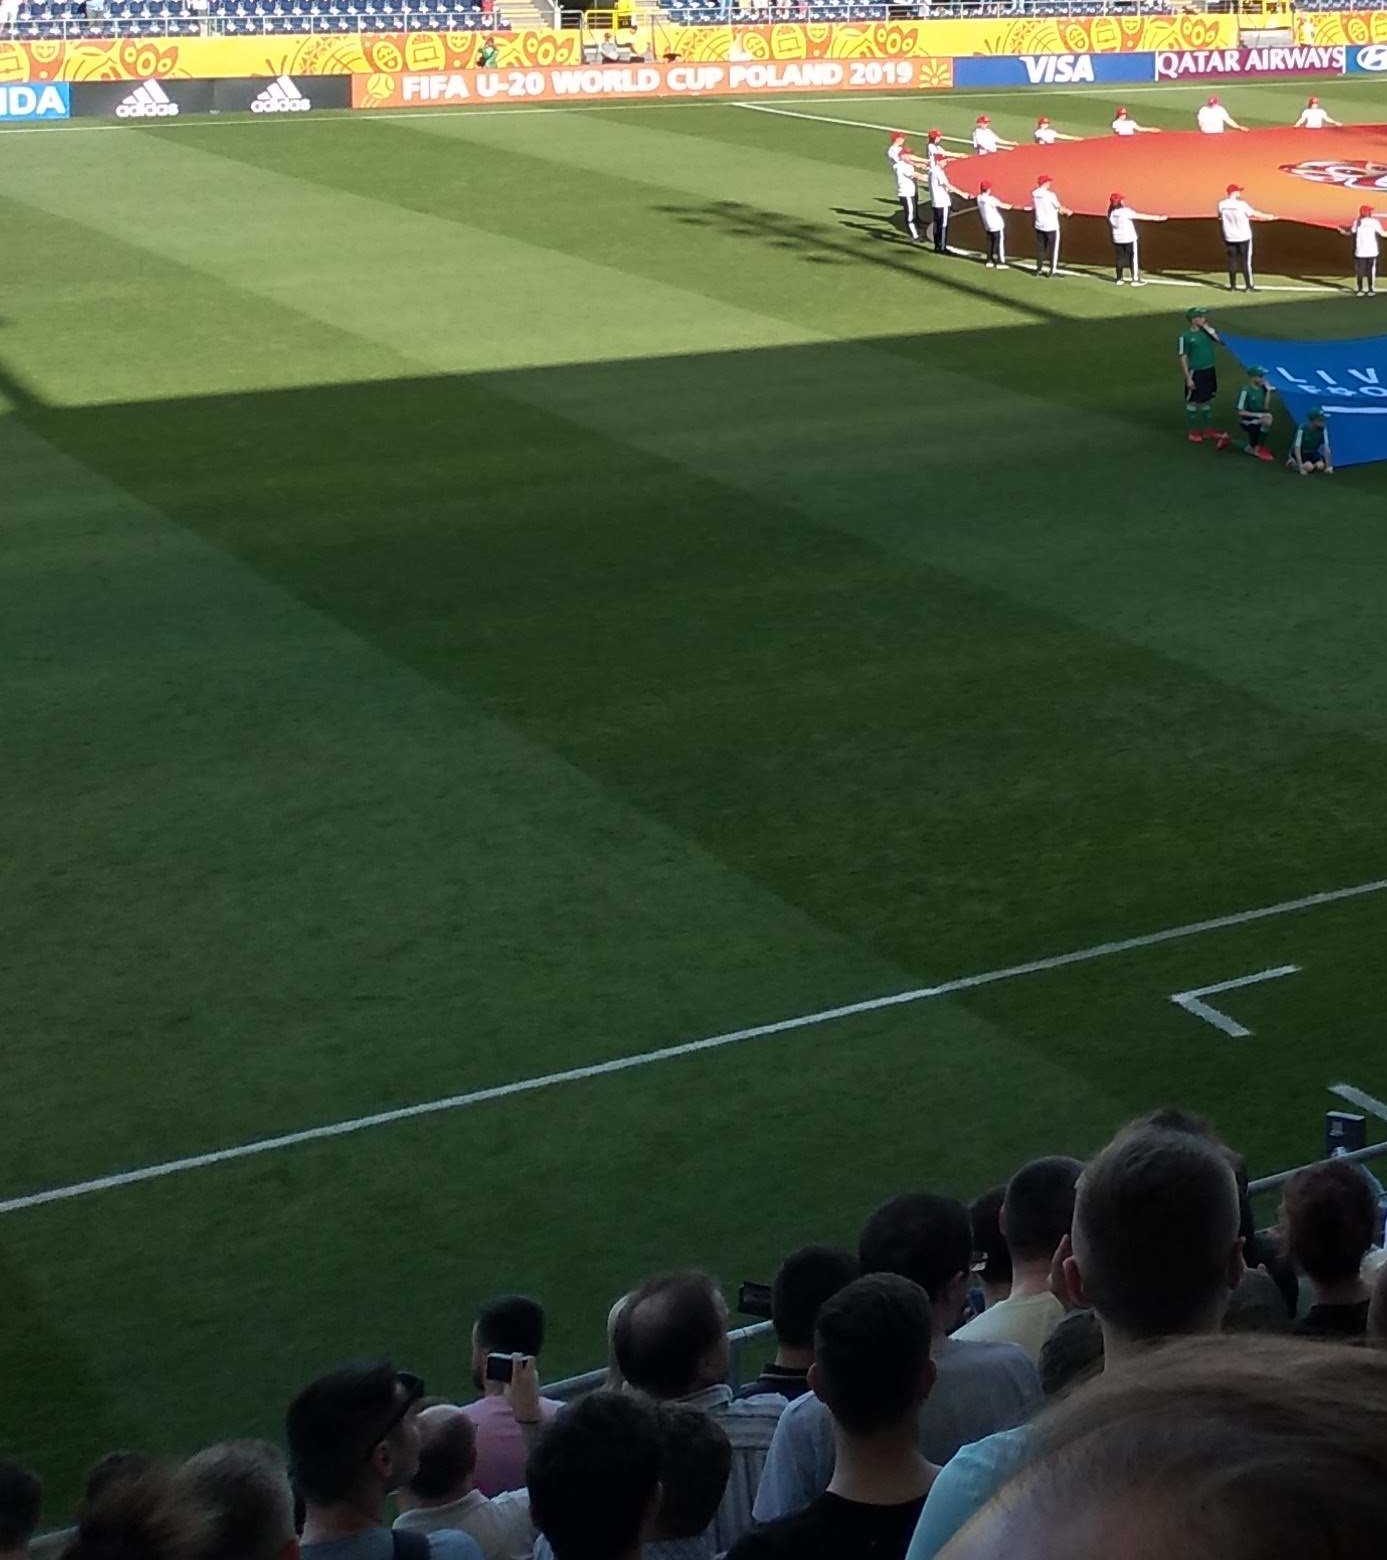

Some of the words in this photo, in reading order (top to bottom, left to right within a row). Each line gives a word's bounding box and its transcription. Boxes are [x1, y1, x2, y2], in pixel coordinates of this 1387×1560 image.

[1018, 54, 1094, 84] VISA
[1158, 49, 1240, 79] QATAR
[1245, 45, 1345, 73] AIRWAYS
[403, 74, 470, 100] FIFA
[477, 72, 544, 98] U-20
[551, 69, 658, 94] WORLD
[667, 66, 720, 92] CUP
[730, 62, 843, 89] POLAND
[849, 60, 913, 85] 2019
[0, 85, 66, 116] DA
[115, 101, 180, 118] adidas
[250, 97, 311, 113] adidas
